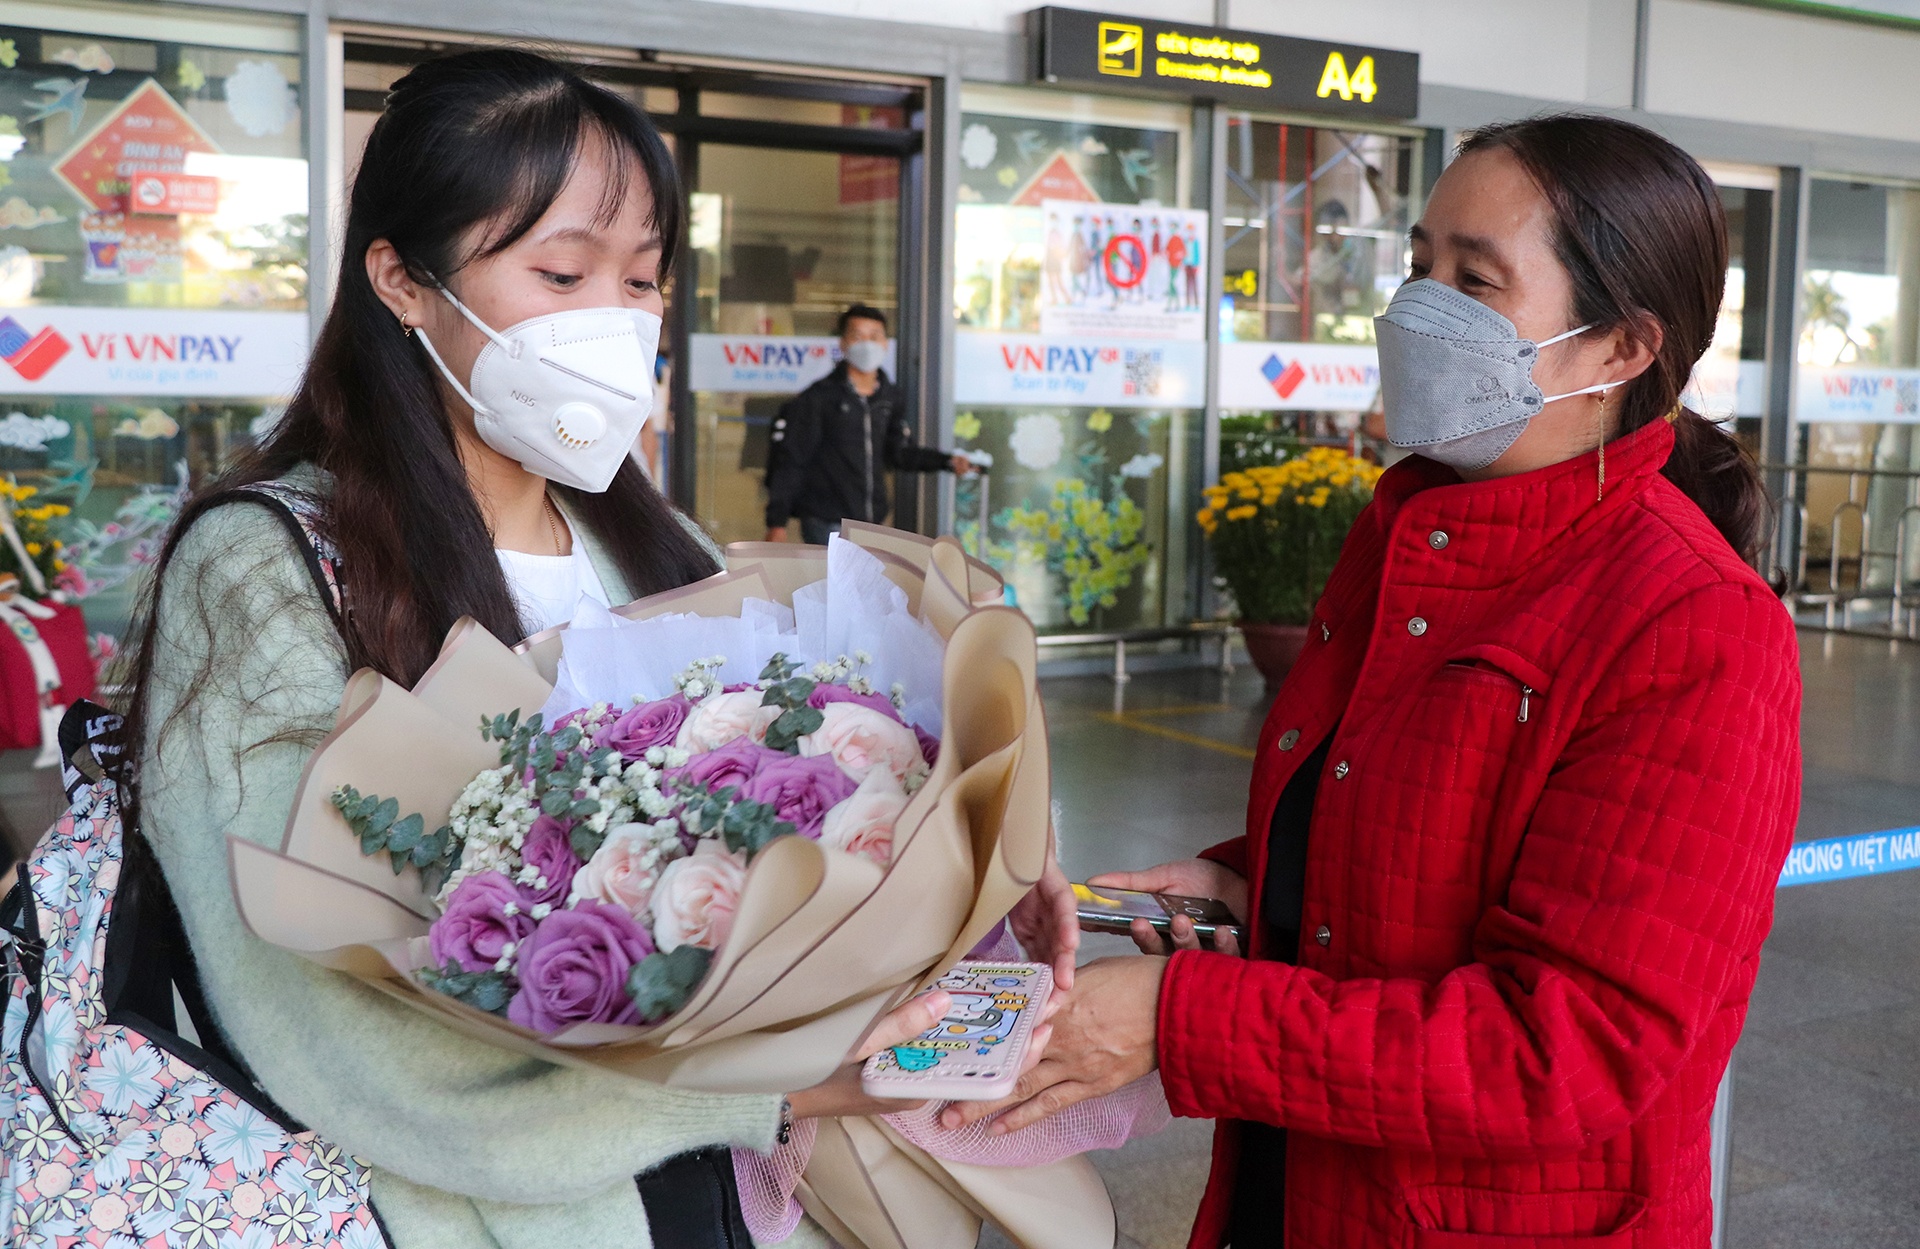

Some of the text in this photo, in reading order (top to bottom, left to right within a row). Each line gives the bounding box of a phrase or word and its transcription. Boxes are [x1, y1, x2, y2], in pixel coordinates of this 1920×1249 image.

[1317, 51, 1377, 103] A4
[124, 334, 242, 362] VNPAY
[510, 390, 537, 408] N95
